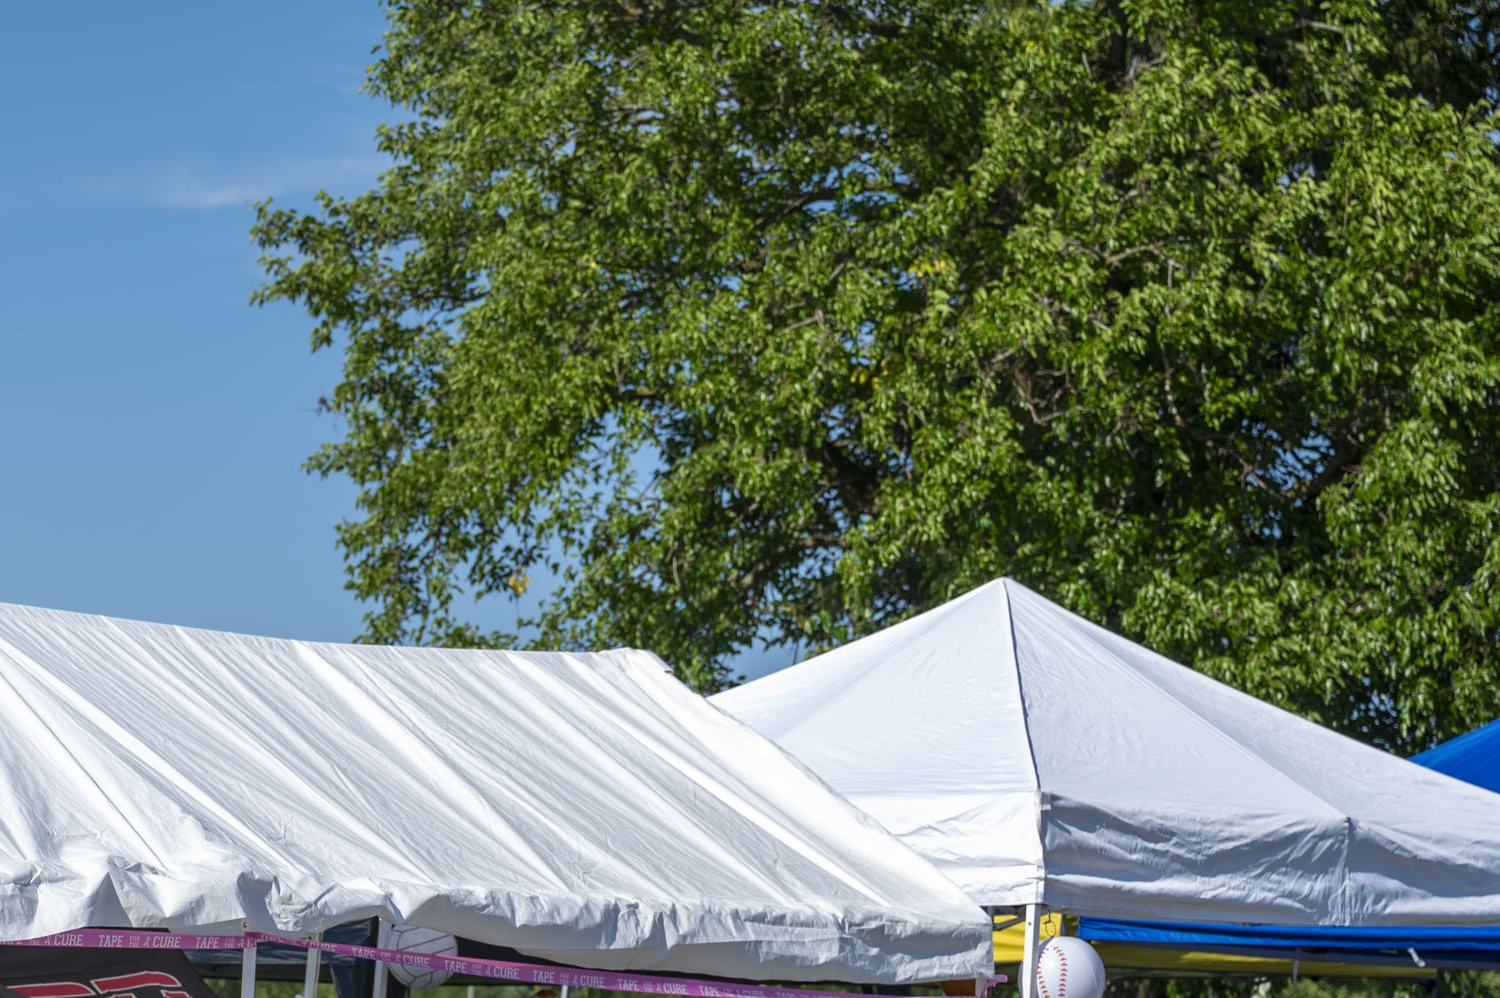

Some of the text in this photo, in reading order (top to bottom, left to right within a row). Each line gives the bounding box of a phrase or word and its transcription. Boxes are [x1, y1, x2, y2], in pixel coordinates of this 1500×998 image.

[54, 934, 84, 946] CURE
[99, 934, 123, 947] TAPE
[153, 935, 181, 948] CURE
[195, 936, 219, 949] TAPE
[403, 954, 430, 968] CURE
[444, 959, 466, 974] TAPE
[493, 965, 520, 980] CURE
[533, 969, 555, 984] TAPE
[580, 974, 605, 988] CURE
[617, 978, 688, 994] TAPE CURE
